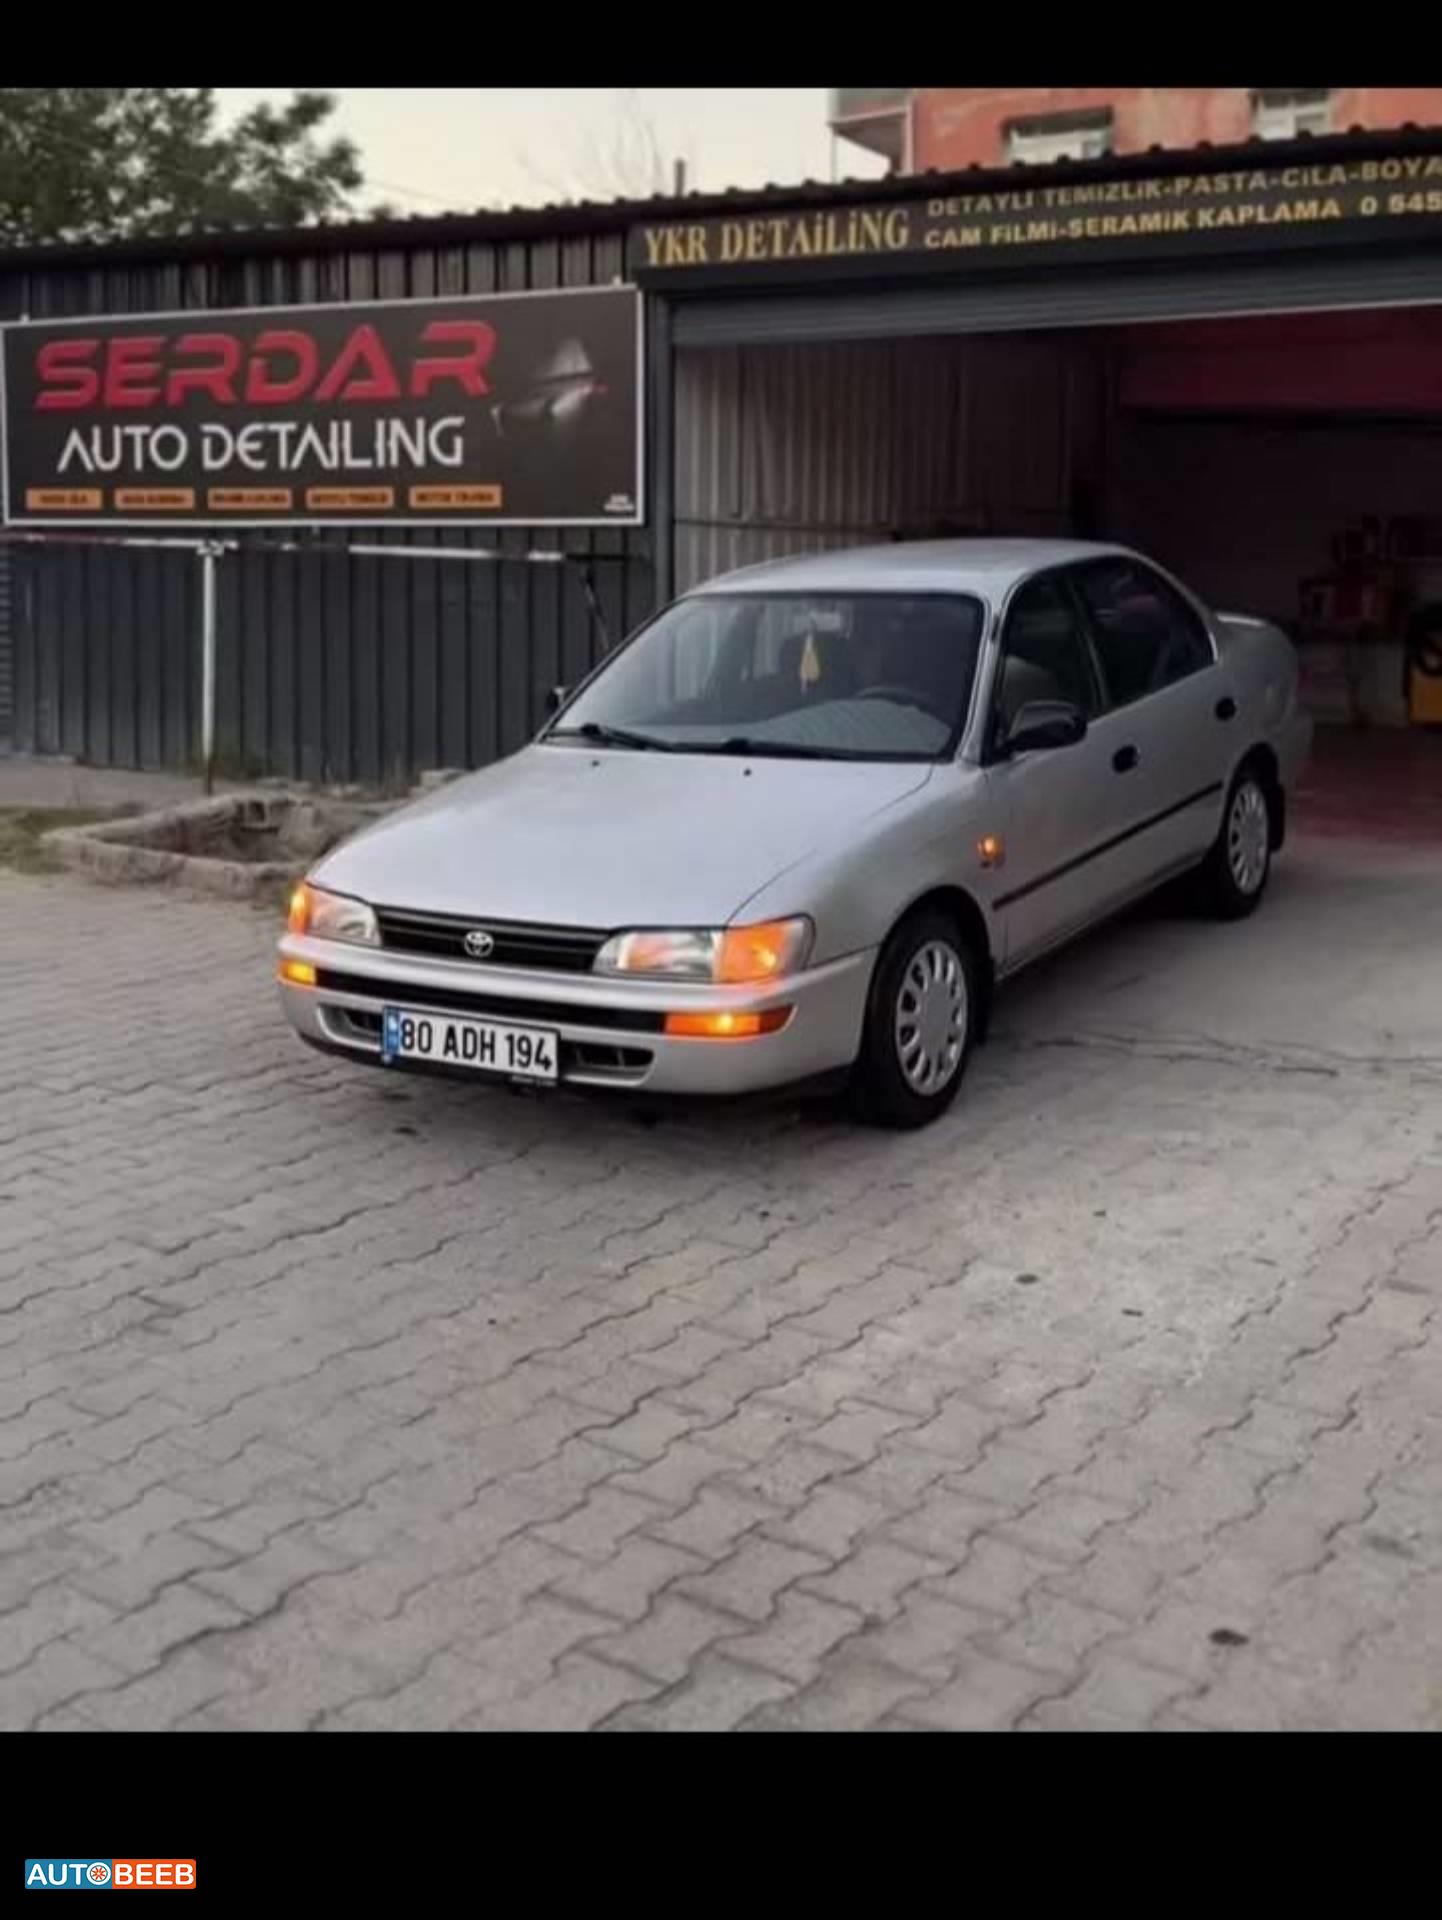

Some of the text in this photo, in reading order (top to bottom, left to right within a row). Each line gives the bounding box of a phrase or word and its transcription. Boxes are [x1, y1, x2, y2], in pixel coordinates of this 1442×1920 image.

[925, 226, 981, 249] CAM
[1198, 198, 1342, 229] KAPLAMA
[1360, 196, 1378, 217] 0
[928, 190, 1034, 217] DETAYLI
[644, 225, 708, 267] YKR
[34, 320, 496, 410] SERDAR
[57, 416, 465, 472] AUTO DETAILING
[401, 1018, 552, 1072] 80 ADH 194
